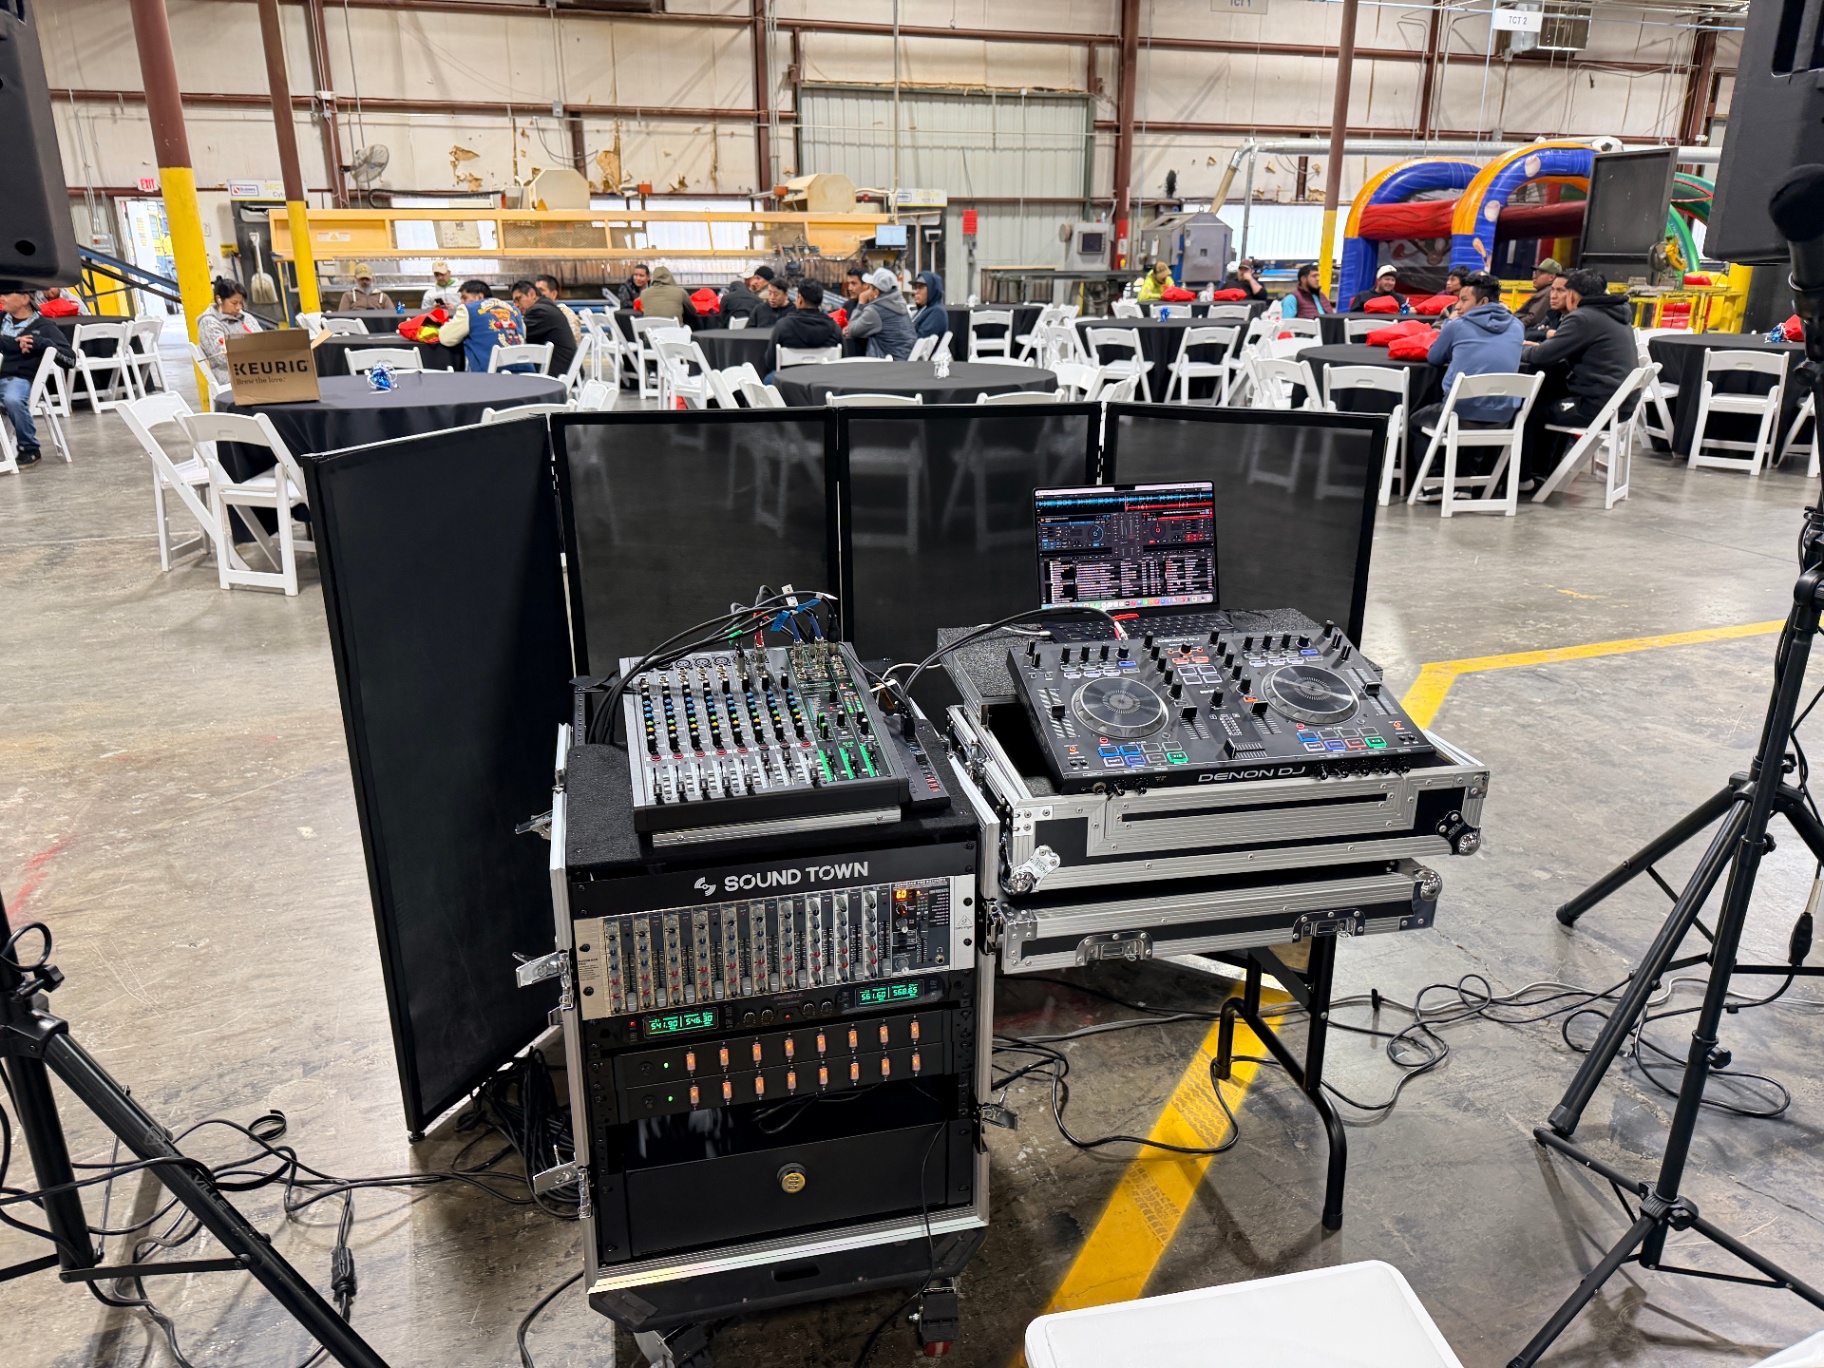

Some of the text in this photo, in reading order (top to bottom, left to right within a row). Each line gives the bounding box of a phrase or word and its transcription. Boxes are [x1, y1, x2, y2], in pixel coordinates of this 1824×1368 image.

[1508, 15, 1528, 25] TCT 2
[140, 178, 155, 190] EXIT
[233, 360, 308, 376] KEURIG
[236, 378, 254, 386] Brew
[255, 376, 267, 384] the
[1198, 766, 1306, 782] DENON DJ
[724, 861, 869, 892] SOUND TOWN
